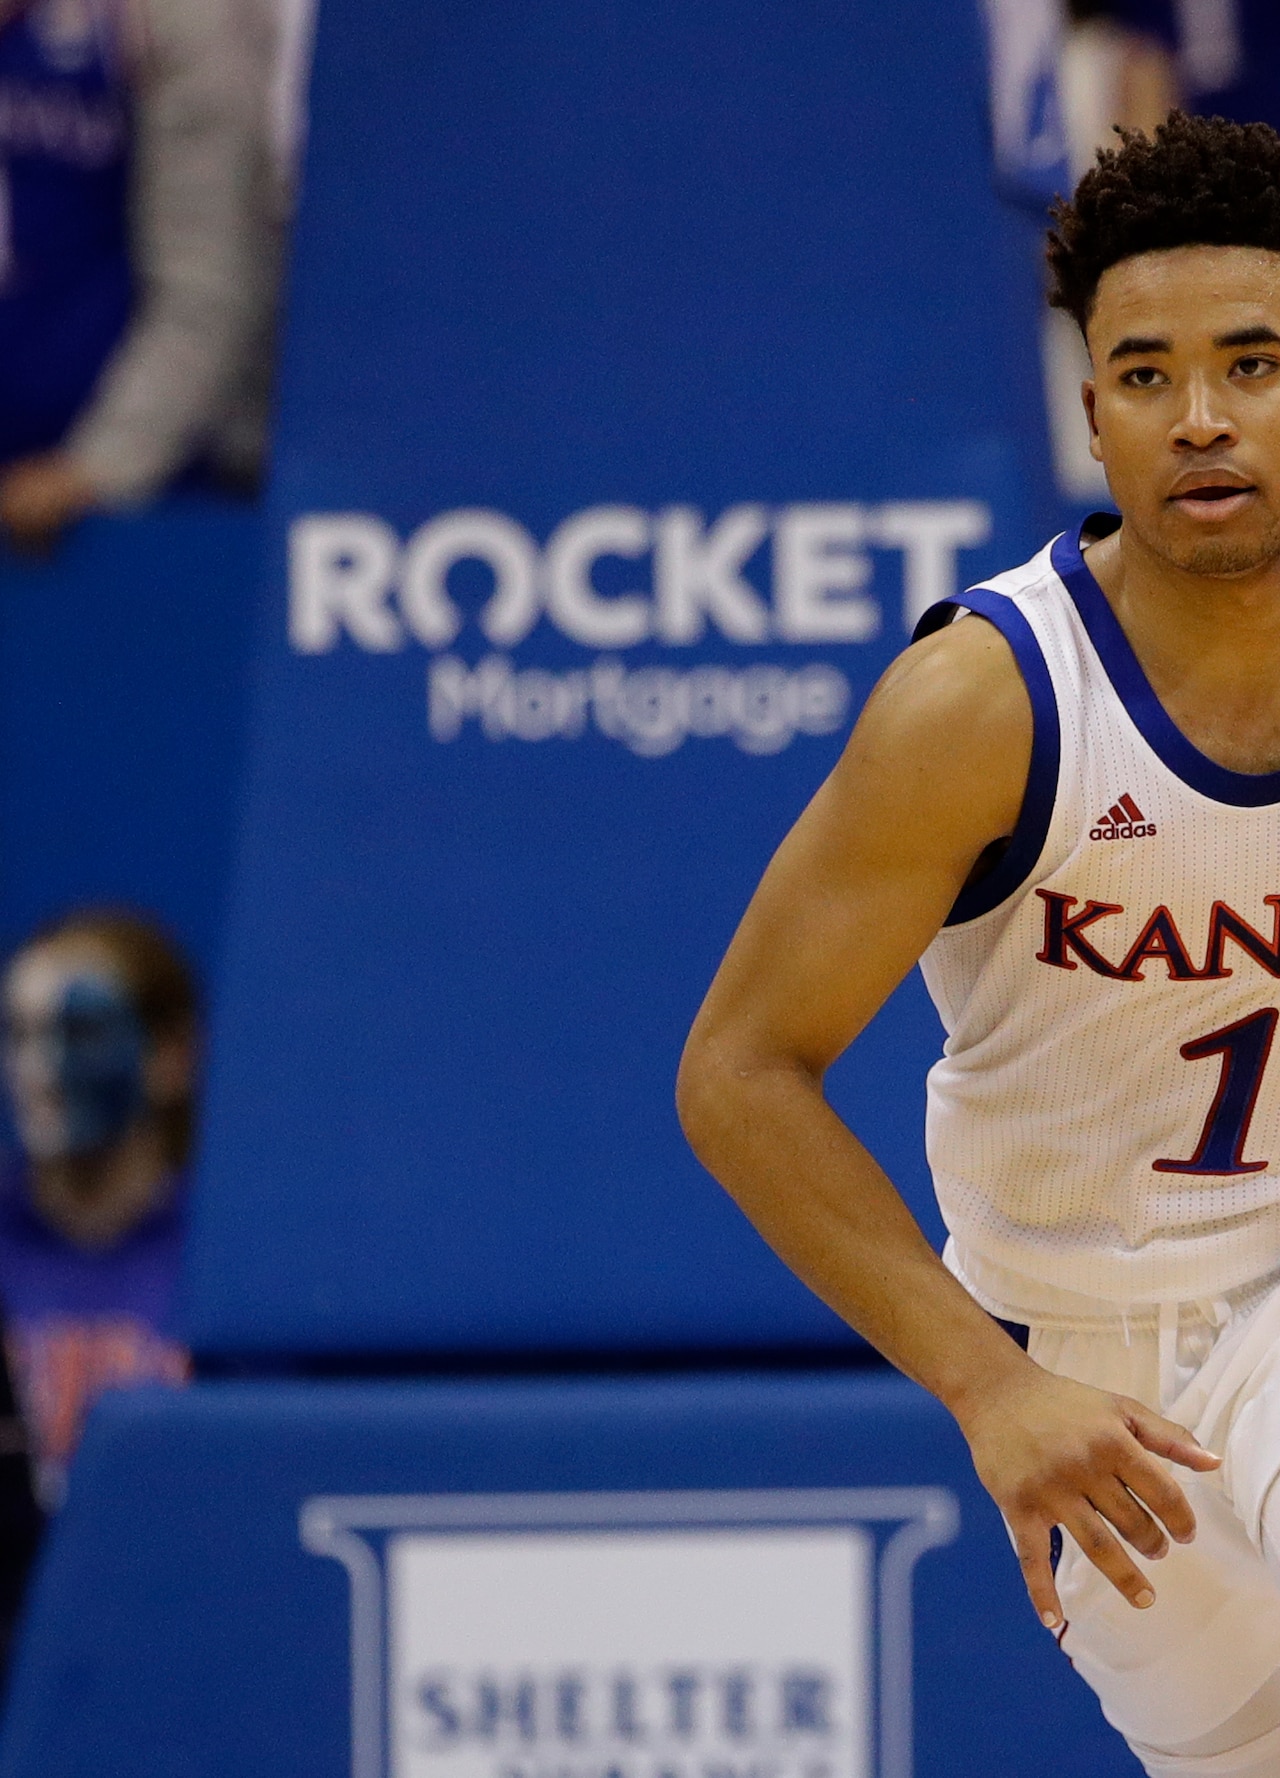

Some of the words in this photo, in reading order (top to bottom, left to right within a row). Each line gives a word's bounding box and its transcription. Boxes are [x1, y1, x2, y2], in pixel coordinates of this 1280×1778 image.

[288, 503, 990, 653] ROCKET
[427, 657, 850, 756] Mortgage
[1089, 819, 1157, 841] adidas
[1152, 1006, 1280, 1176] 1
[415, 1664, 832, 1752] SHELTER
